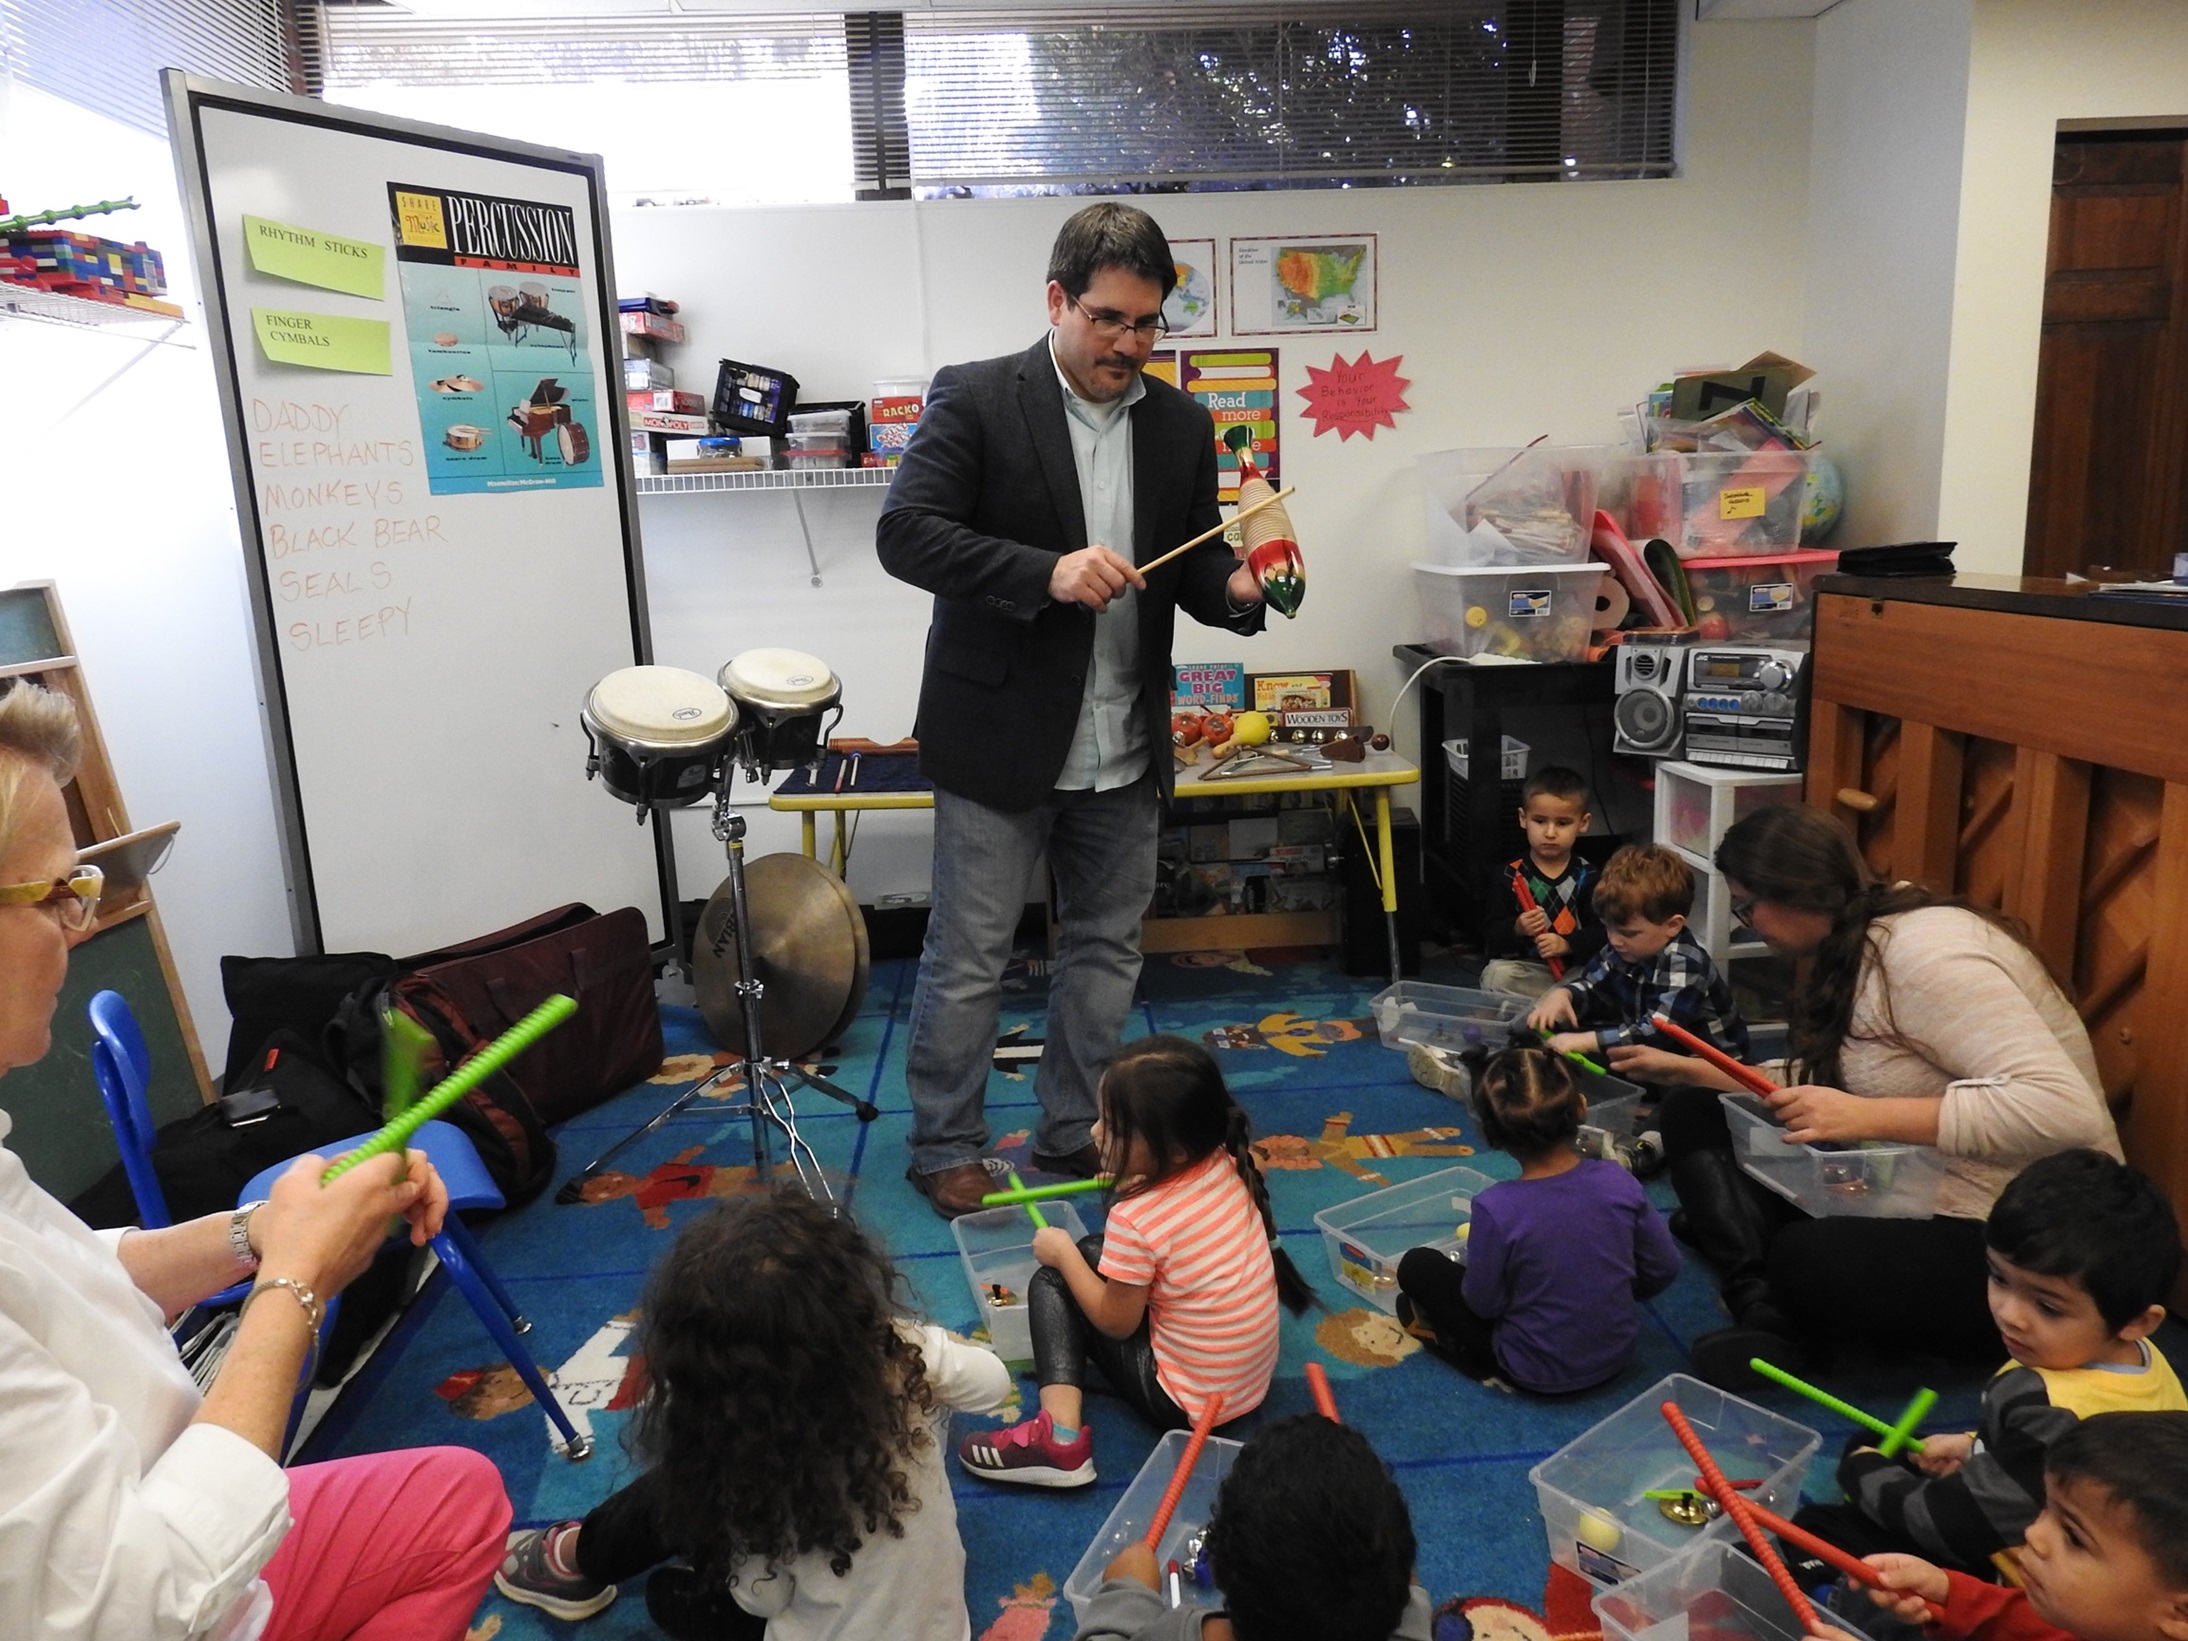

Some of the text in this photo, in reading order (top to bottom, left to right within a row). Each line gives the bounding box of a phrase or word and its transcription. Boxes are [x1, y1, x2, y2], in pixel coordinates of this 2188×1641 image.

[402, 197, 437, 212] SHARE
[446, 195, 575, 265] PERCUSSION
[259, 224, 368, 259] RHYTHM STICKS
[460, 259, 575, 276] FAMILY
[266, 314, 313, 330] FINGER
[270, 331, 330, 347] CYMBALS
[1207, 391, 1246, 410] Read
[253, 398, 348, 437] DADDY
[1222, 410, 1261, 421] more
[258, 439, 415, 469] ELEPHANTS
[264, 479, 404, 516] MONKEYS
[268, 514, 449, 561] BLACK BEAR
[289, 596, 412, 652] SLEEPY
[1178, 669, 1237, 683] GREAT
[1191, 681, 1223, 694] BIG
[1256, 680, 1289, 692] Know
[1177, 692, 1239, 705] WORD-FINDS
[1286, 711, 1348, 725] WOODEN TOYS
